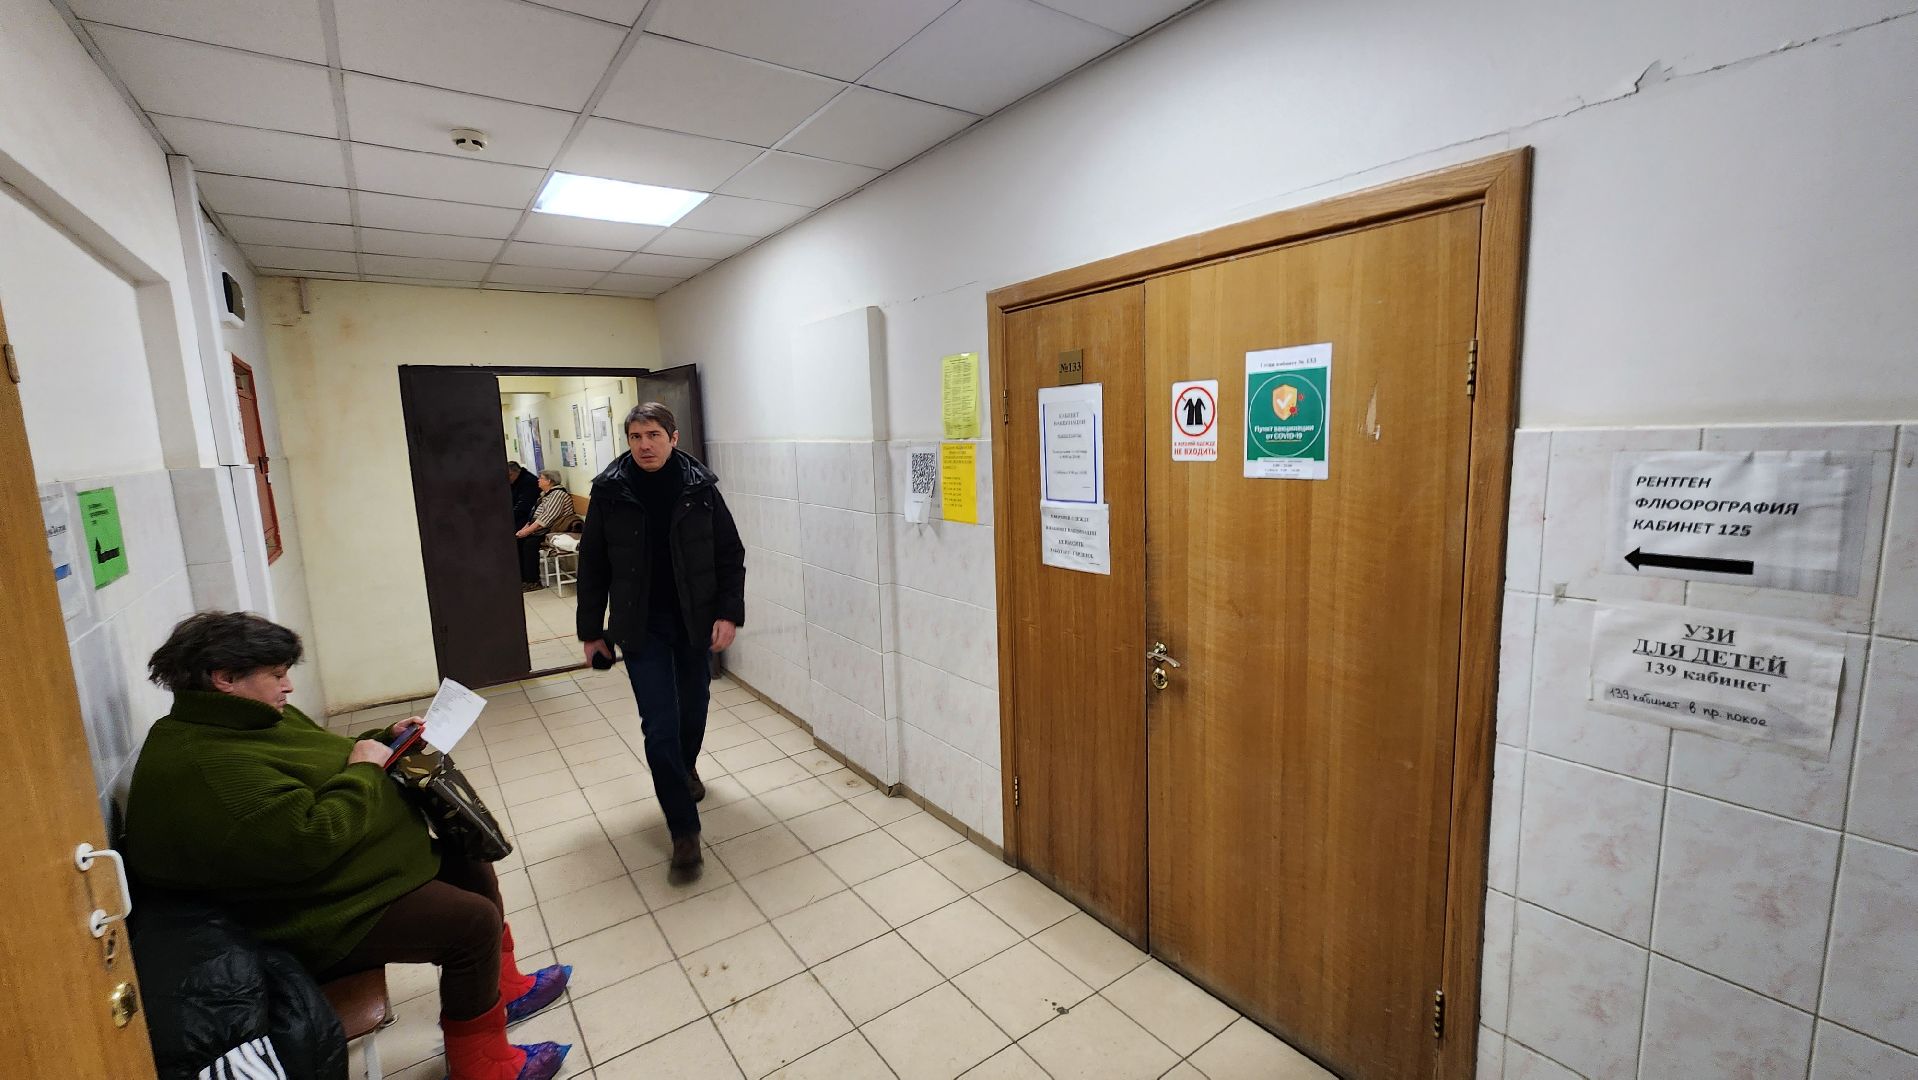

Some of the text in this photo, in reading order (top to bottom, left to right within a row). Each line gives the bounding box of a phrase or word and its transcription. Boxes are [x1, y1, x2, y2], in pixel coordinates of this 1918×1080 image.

[1058, 361, 1082, 374] №133
[1273, 432, 1303, 440] COVID-19
[1174, 447, 1216, 457] НЕ ВХОДИТЬ
[1635, 475, 1712, 489] РЕНТГЕН
[1634, 497, 1800, 516] ФЛЮОРОГРАФИЯ
[1632, 519, 1752, 537] КАБИНЕТ 125
[1683, 623, 1736, 645] УЗИ
[1632, 638, 1790, 676] ДЛЯ ДЕТЕЙ
[1645, 660, 1772, 693] 139 кабинет
[1609, 688, 1768, 727] 139 кабинет в пр. покое
